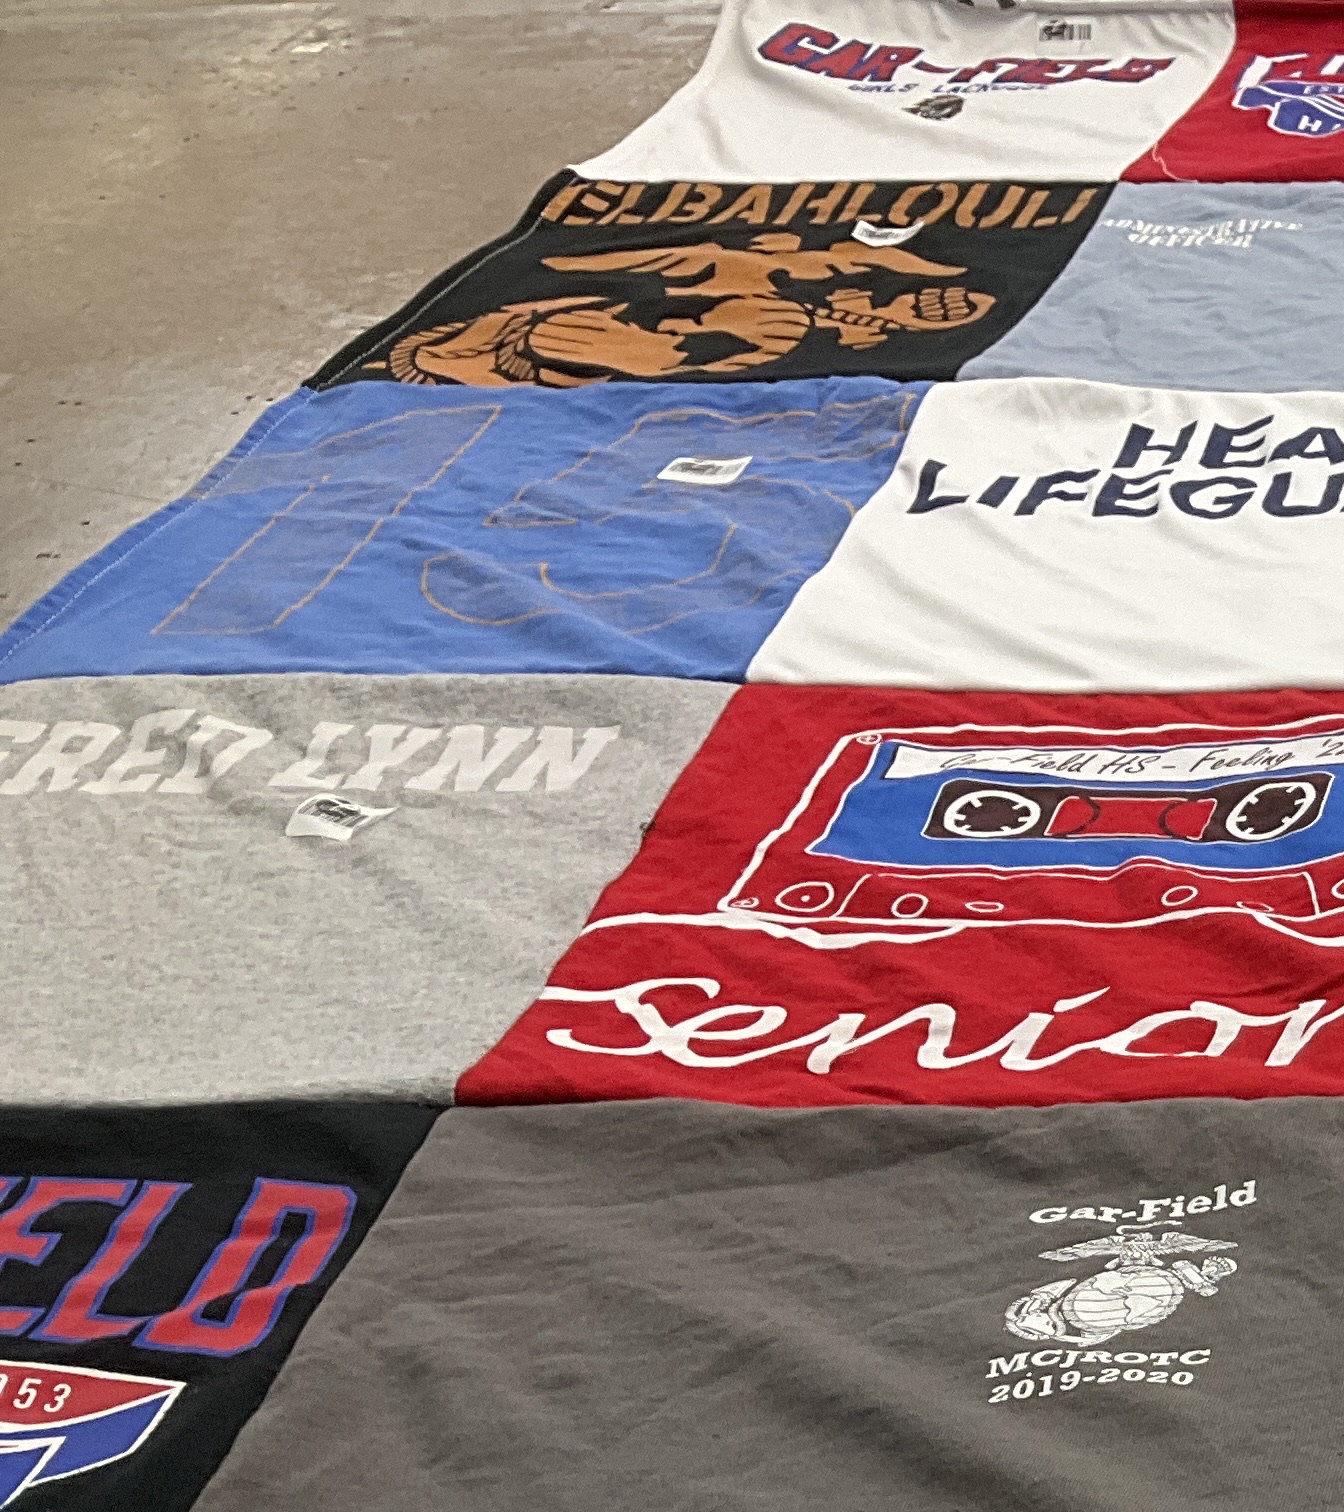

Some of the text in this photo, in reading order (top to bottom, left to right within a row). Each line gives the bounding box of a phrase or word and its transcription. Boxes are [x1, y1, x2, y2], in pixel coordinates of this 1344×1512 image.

[540, 181, 1099, 228] ELBAHLOULI
[268, 720, 621, 794] LYNN
[1097, 754, 1163, 775] HS
[1188, 746, 1296, 772] Feeling
[1029, 1179, 1257, 1224] Gar-Field
[0, 1176, 358, 1357] ELD
[984, 1348, 1211, 1379] MCJROTC
[987, 1368, 1194, 1404] 2019-2020
